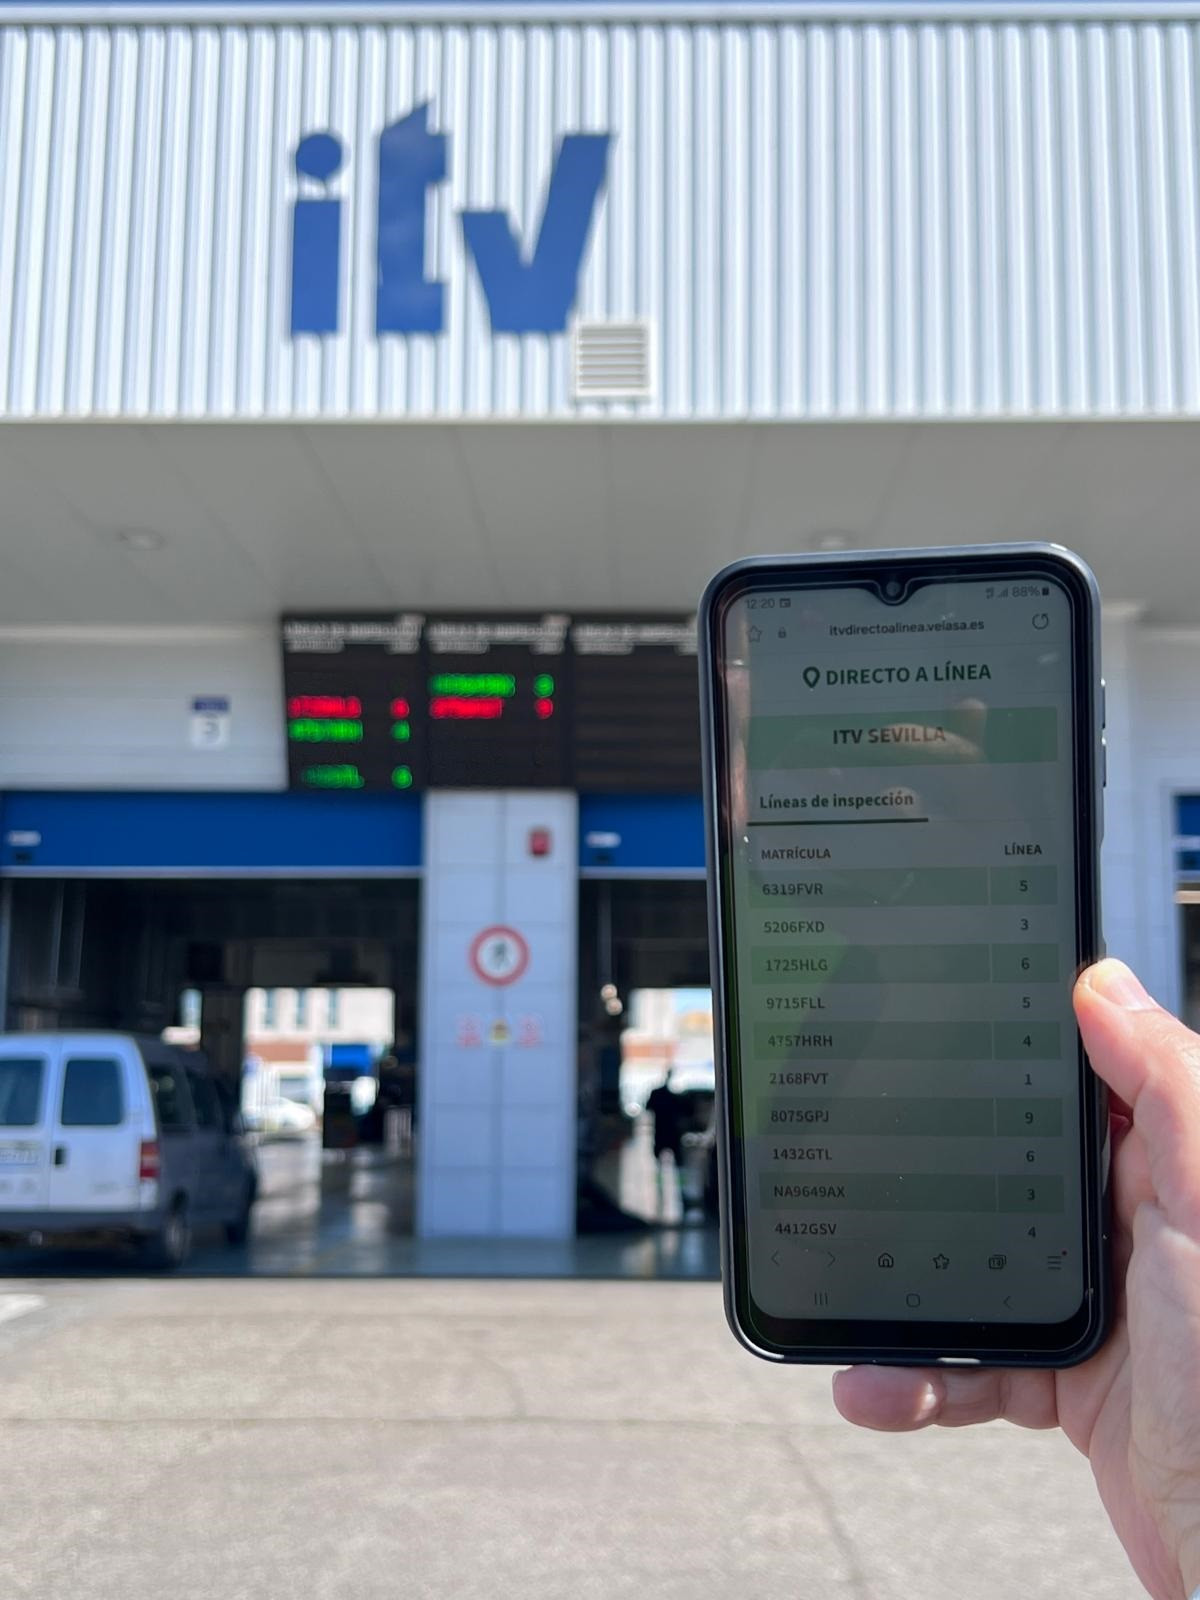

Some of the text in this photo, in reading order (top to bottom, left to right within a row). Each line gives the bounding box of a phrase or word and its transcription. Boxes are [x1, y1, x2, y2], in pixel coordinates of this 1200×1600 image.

[291, 101, 611, 334] itv
[1012, 586, 1040, 598] 88%
[746, 598, 775, 609] 12:20
[826, 661, 991, 686] DIRECTO A LÍNEA
[833, 726, 946, 744] ITV SEVILLA
[760, 792, 914, 810] Líneas de inspección
[761, 845, 832, 860] MATRÍCULA
[1004, 842, 1043, 856] LÍNEA
[762, 883, 824, 896] 6319FVR
[1019, 879, 1028, 893] 5
[764, 920, 825, 933] 5206FXD
[1020, 918, 1029, 931] 3
[765, 958, 828, 971] 1725HLG
[1021, 957, 1030, 970] 6
[766, 997, 825, 1009] 9715FLL
[1022, 996, 1030, 1009] 5
[768, 1034, 833, 1048] 4757HRH
[1023, 1034, 1032, 1047] 4
[769, 1072, 829, 1085] 2168FVT
[1024, 1073, 1032, 1086] 1
[770, 1110, 829, 1123] 8075GPJ
[1024, 1111, 1034, 1124] 9
[772, 1148, 833, 1161] 1432GTL
[1026, 1150, 1035, 1163] 6
[774, 1185, 845, 1198] NA9649AX
[1027, 1188, 1035, 1201] 3
[775, 1223, 837, 1236] 4412GSV
[1028, 1226, 1036, 1238] 4
